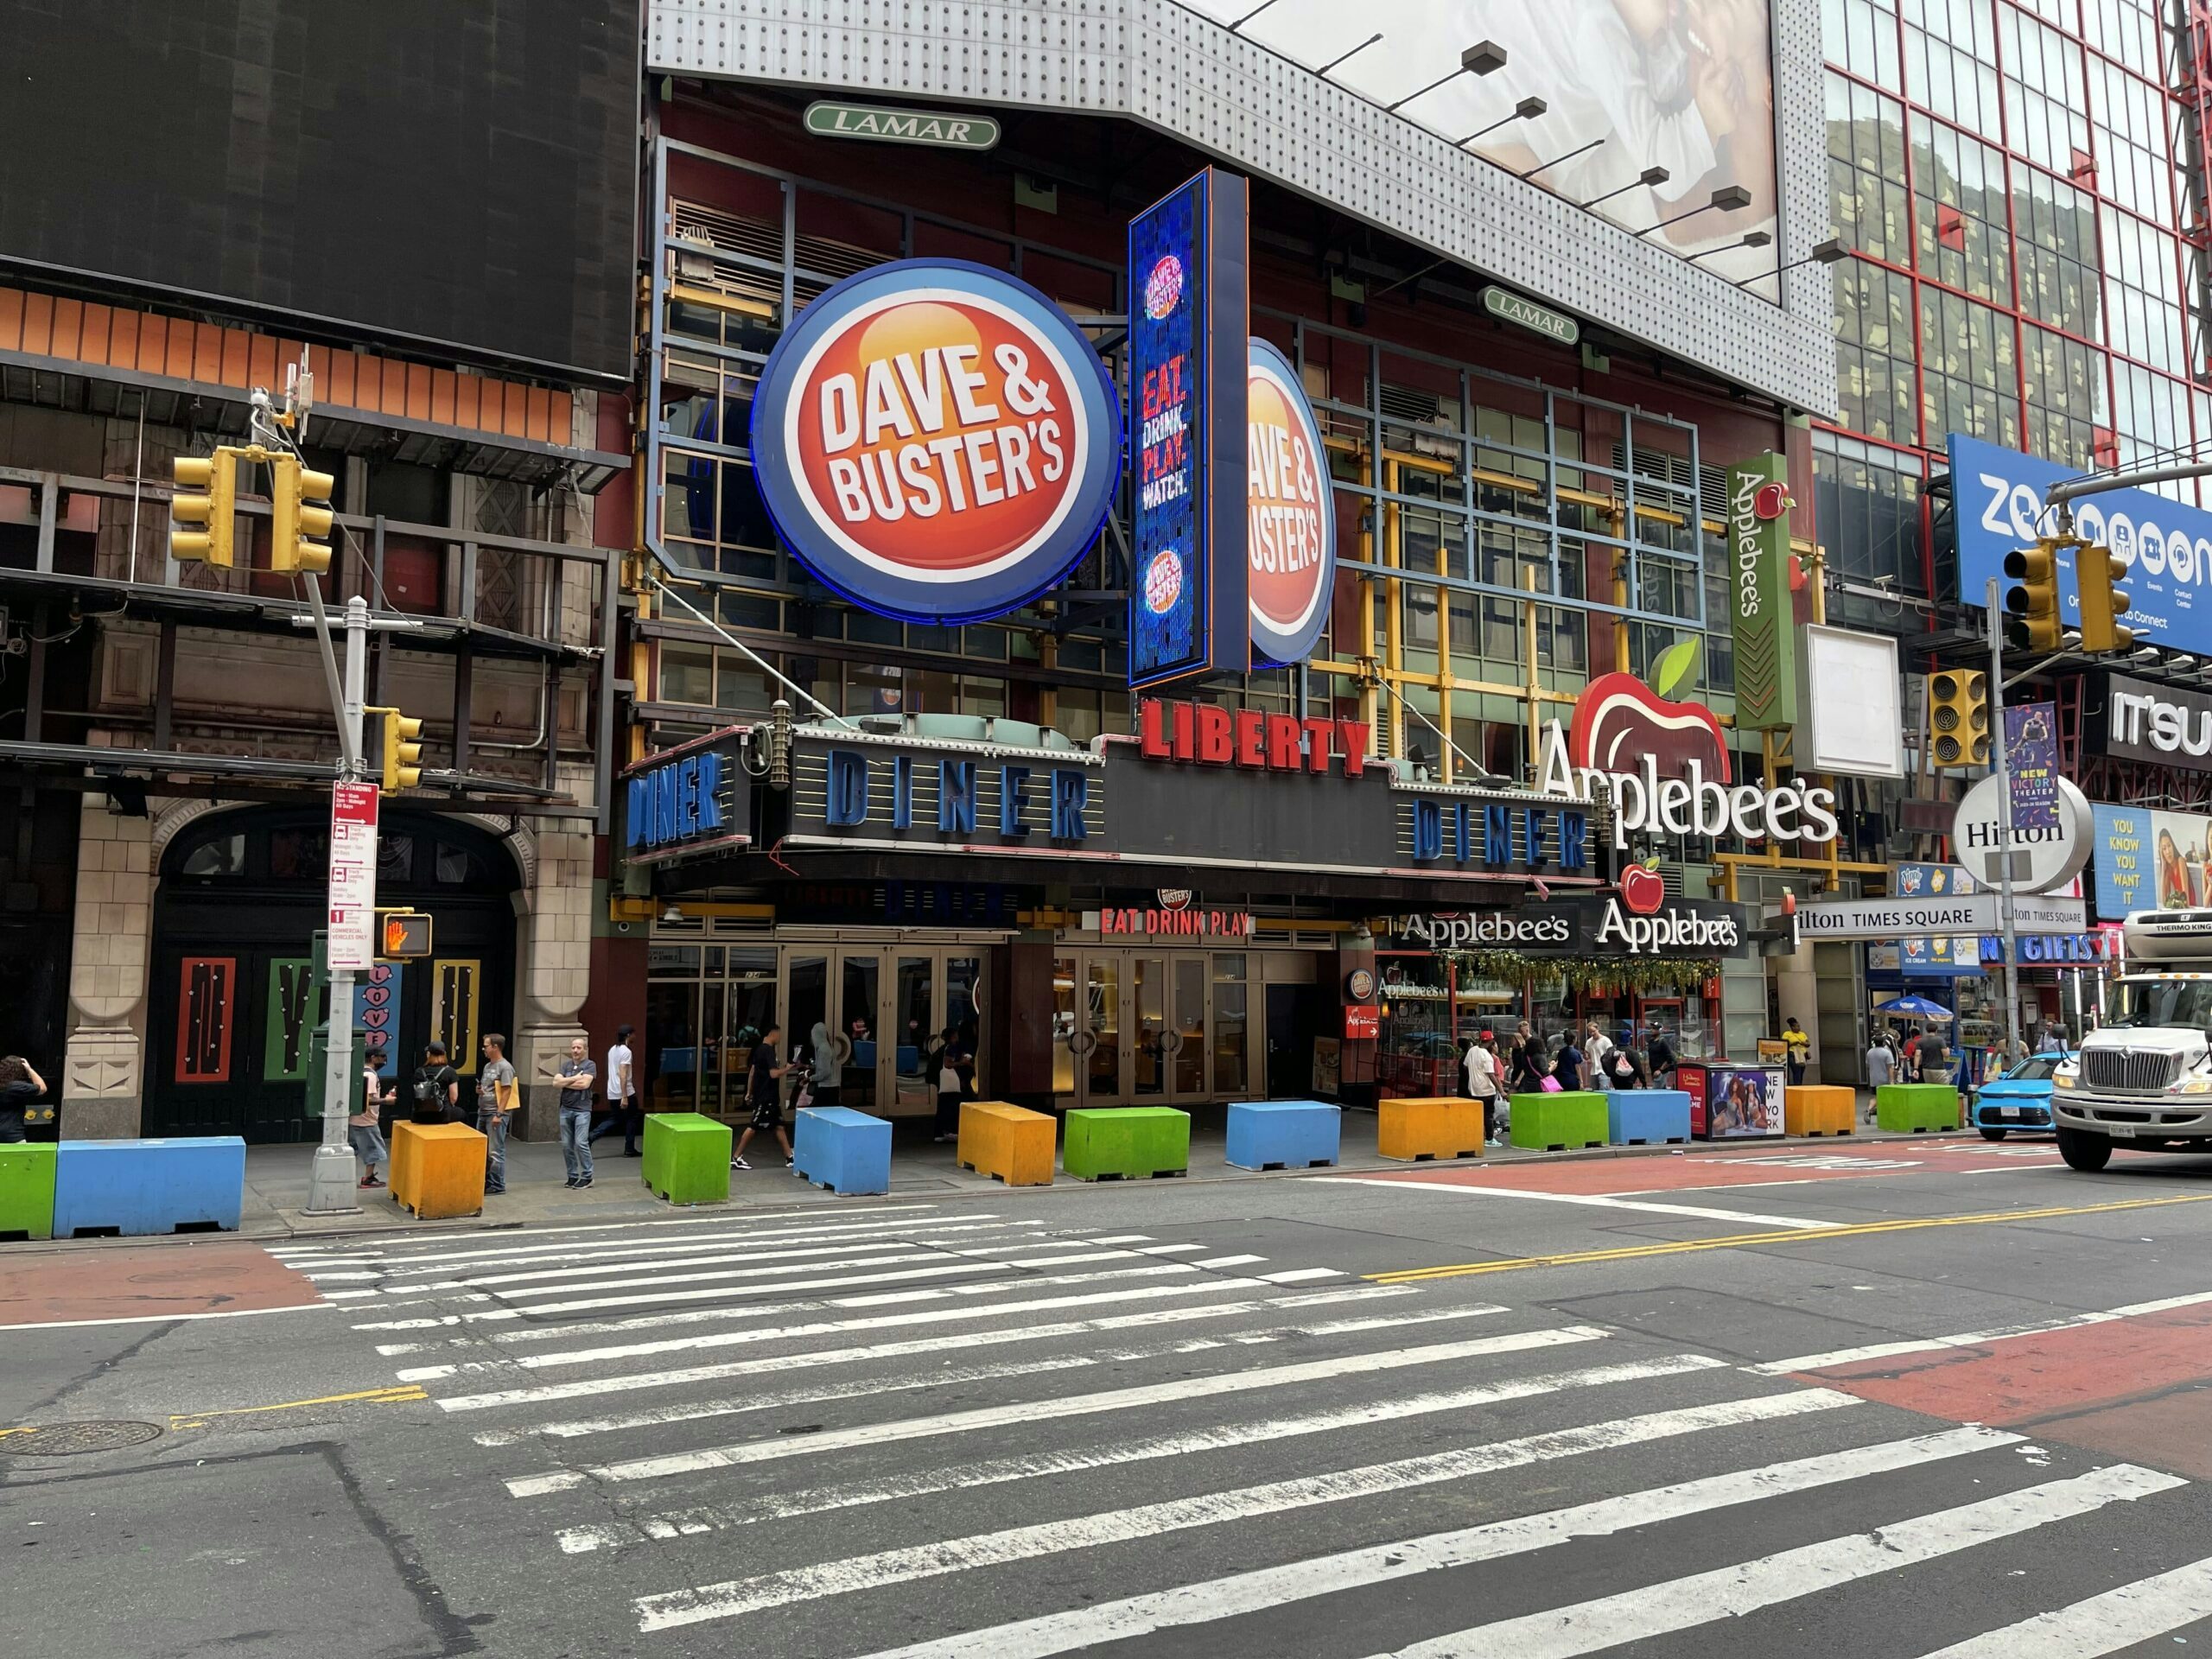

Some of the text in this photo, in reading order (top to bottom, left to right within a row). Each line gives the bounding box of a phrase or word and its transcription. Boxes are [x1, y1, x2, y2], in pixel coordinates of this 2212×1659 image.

[835, 111, 971, 143] LAMAR
[1498, 297, 1566, 336] LAMAR
[819, 343, 1057, 454] DAVE &
[826, 418, 1065, 523] BUSTER'S
[1249, 423, 1315, 504] AVE &
[1249, 505, 1319, 574] USTER'S
[1732, 470, 1764, 619] Applebee's
[2146, 581, 2163, 593] Events
[2174, 588, 2192, 600] Contact
[2134, 610, 2168, 629] Connect
[2113, 692, 2212, 757] IT'SU
[1141, 697, 1371, 778] LIBERTY
[2012, 778, 2056, 790] VICTORY
[2020, 768, 2048, 779] NEW
[627, 753, 725, 848] DINER
[825, 749, 1088, 841] DINER
[2015, 788, 2054, 797] THEATER
[1412, 798, 1586, 868] DINER
[1966, 821, 2064, 848] Hiton
[2113, 819, 2133, 835] YOU
[2109, 836, 2139, 852] KNOW
[2115, 855, 2136, 870] YOU
[2113, 873, 2140, 888] WANT
[1162, 892, 1189, 905] BUSTER'S
[2122, 891, 2133, 906] IT
[334, 912, 341, 923] 1
[1101, 908, 1249, 937] EAT DRINK PLAY
[1796, 909, 1974, 929] ilton TIMES SQUARE
[2015, 907, 2082, 923] ton TIMES SQUARE
[1401, 912, 1570, 948] Applebee's
[1596, 898, 1738, 954] Applebee's
[2024, 935, 2093, 960] GIFTS
[1377, 977, 1439, 999] Applebee's
[1765, 1076, 1778, 1086] NE
[1766, 1106, 1779, 1116] YO
[1767, 1119, 1779, 1128] RK
